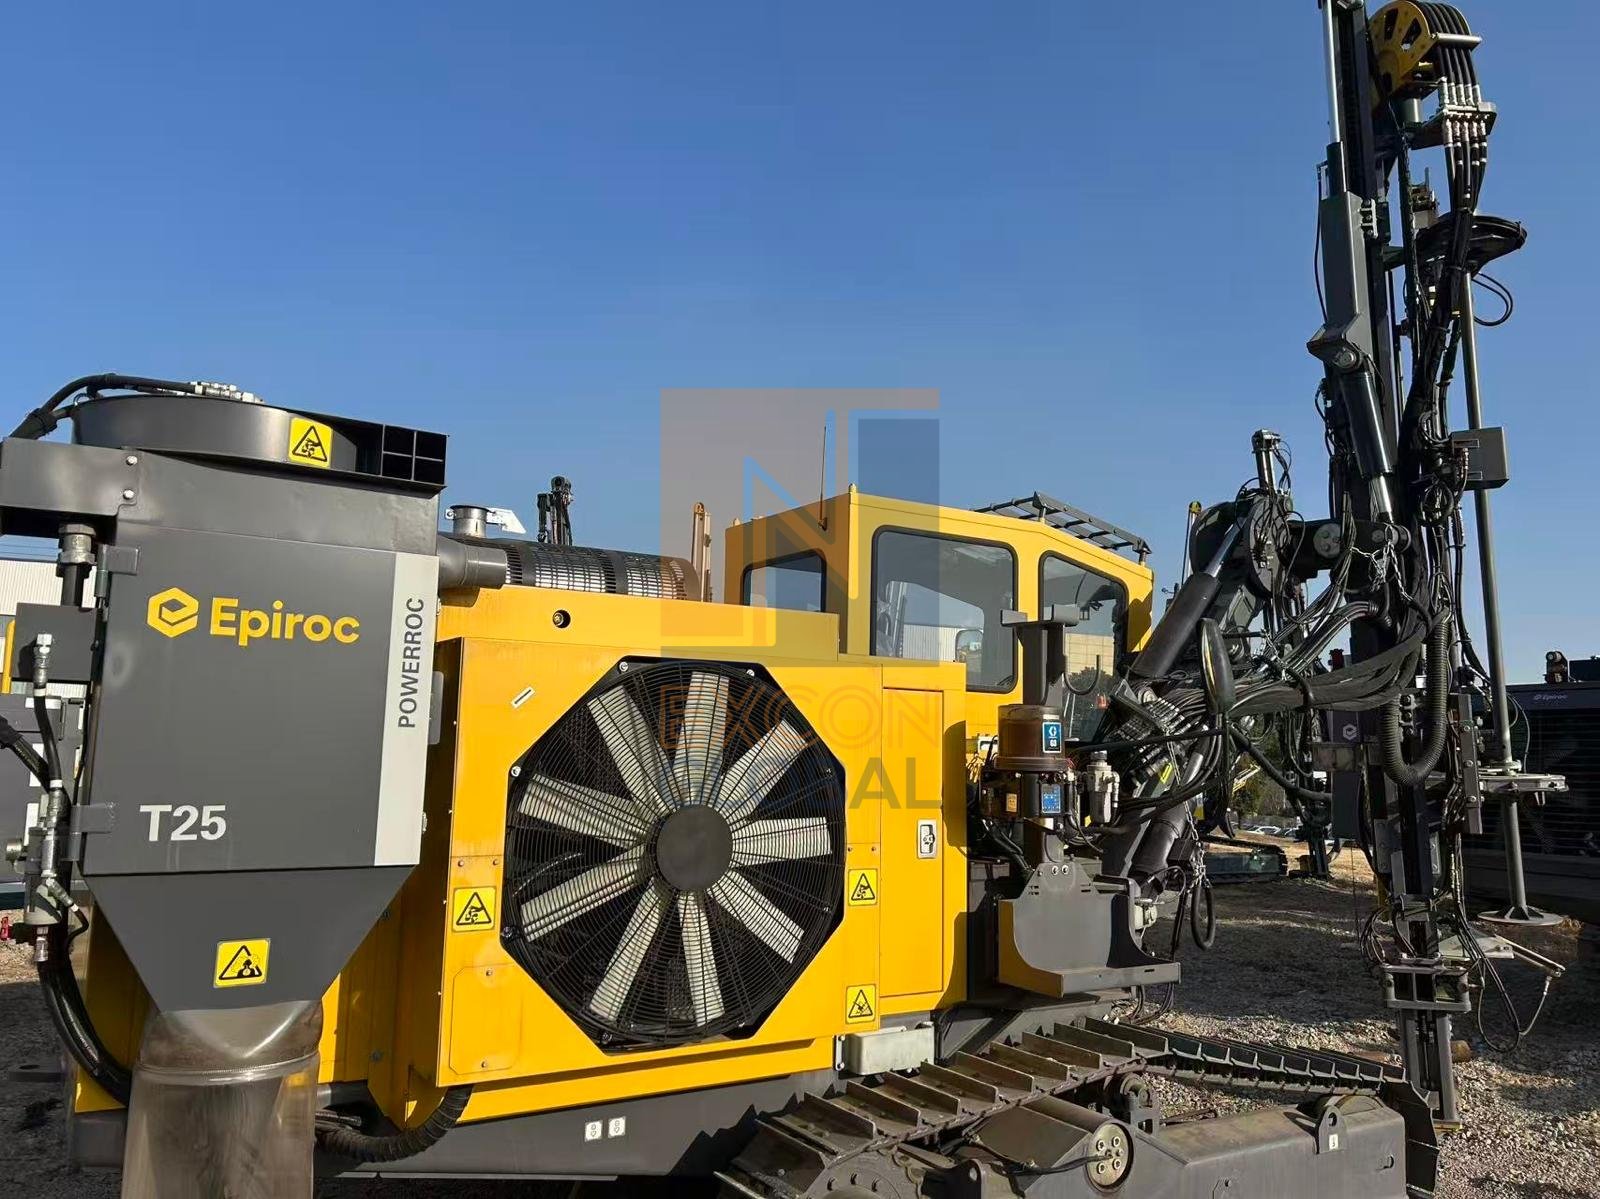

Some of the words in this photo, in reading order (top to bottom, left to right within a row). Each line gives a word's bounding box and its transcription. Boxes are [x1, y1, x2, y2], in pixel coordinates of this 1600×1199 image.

[209, 597, 360, 647] Epiroc
[397, 598, 425, 729] POWERROC
[139, 804, 227, 841] T25
